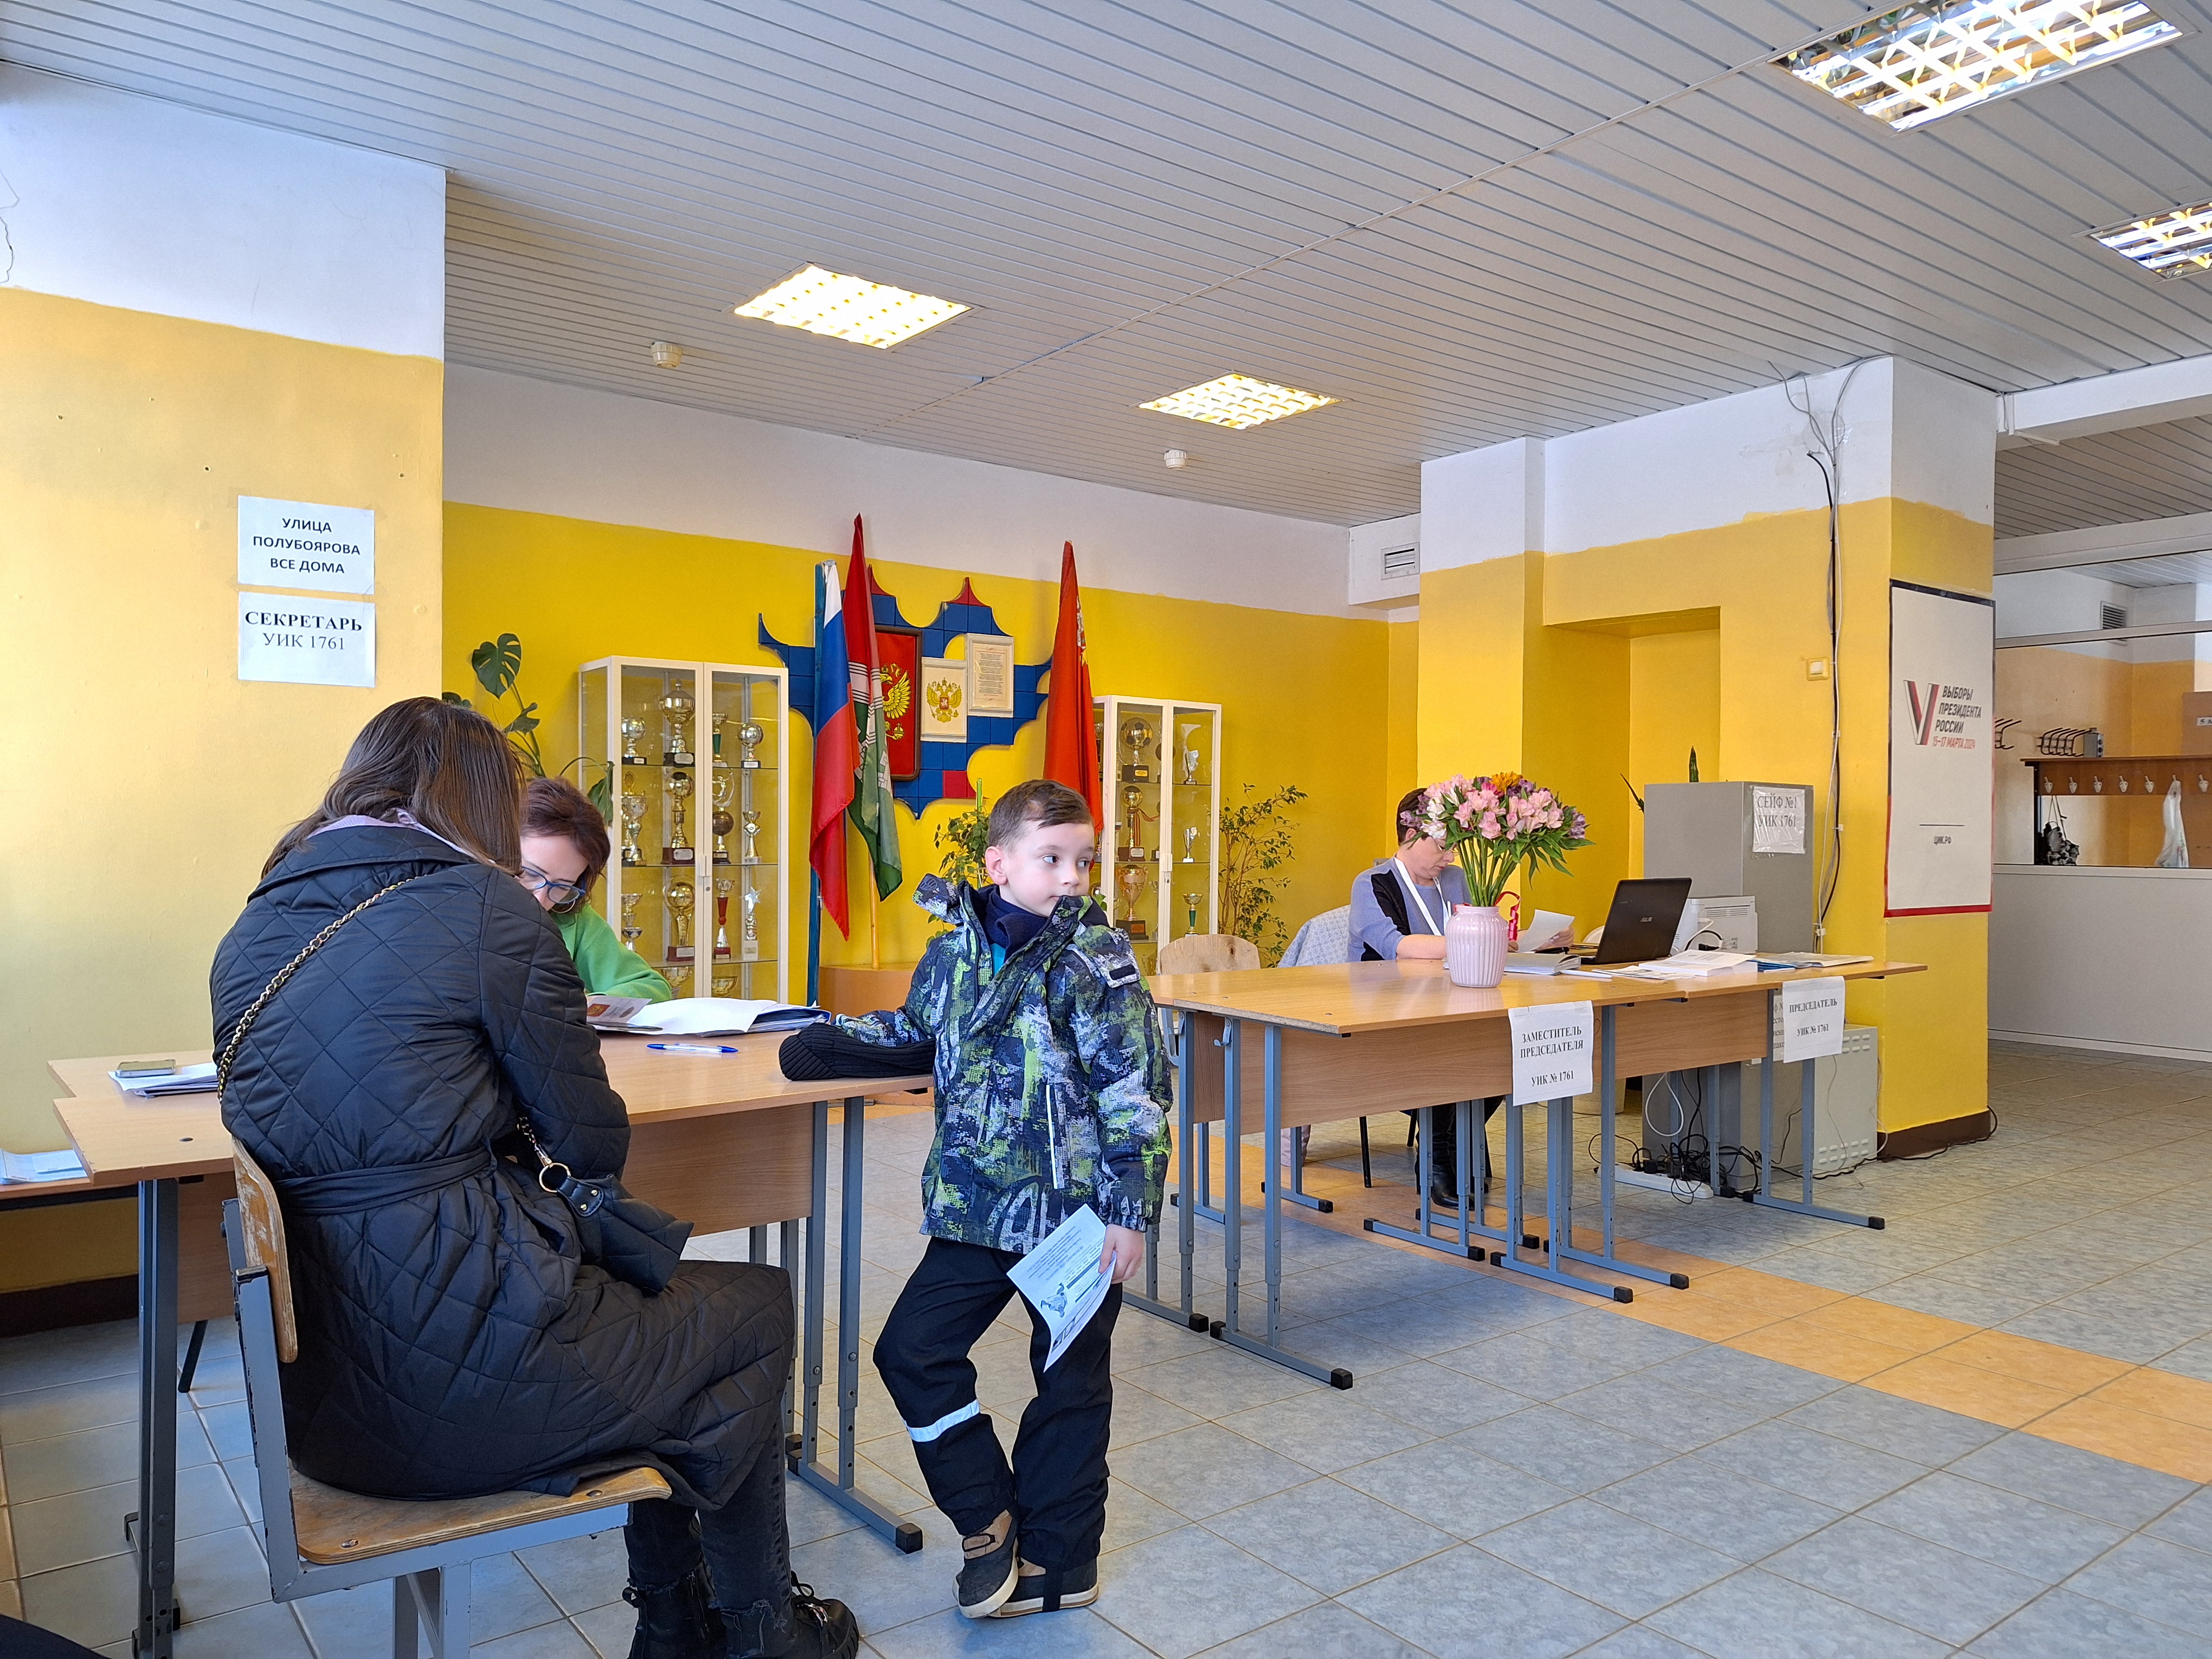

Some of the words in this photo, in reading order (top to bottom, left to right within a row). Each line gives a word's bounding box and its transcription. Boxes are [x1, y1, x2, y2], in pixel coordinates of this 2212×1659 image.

[282, 518, 332, 533] УЛИЦА
[253, 536, 361, 555] ПОЛУБОЯРОВА
[271, 558, 295, 569] ВСЕ
[299, 561, 345, 574] ДОМА
[245, 611, 362, 631] СЕКРЕТАРЬ
[263, 632, 303, 647] УИК
[310, 635, 345, 650] 1761
[1942, 685, 1974, 700] ВЫБОРЫ
[1938, 703, 1982, 718] ПРЕЗИДЕНТА
[1935, 719, 1964, 734] РОССИИ
[1946, 737, 1964, 748] МАРТА
[1964, 738, 1976, 749] 2024
[1758, 793, 1783, 808] СЕЙФ
[1758, 815, 1777, 827] УИК
[1781, 815, 1796, 827] 1761
[1789, 998, 1837, 1013] ПРЕДСЕДАТЕЛЬ
[1522, 1026, 1581, 1043] ЗАМЕСТИТЕЛЬ
[1797, 1026, 1809, 1036] УИК
[1810, 1025, 1816, 1034] №
[1818, 1024, 1829, 1033] 1761
[1520, 1040, 1583, 1058] ПРЕДСЕДАТЕЛЯ
[1531, 1075, 1548, 1086] УИК
[1549, 1073, 1557, 1083] №
[1559, 1070, 1574, 1082] 1761
